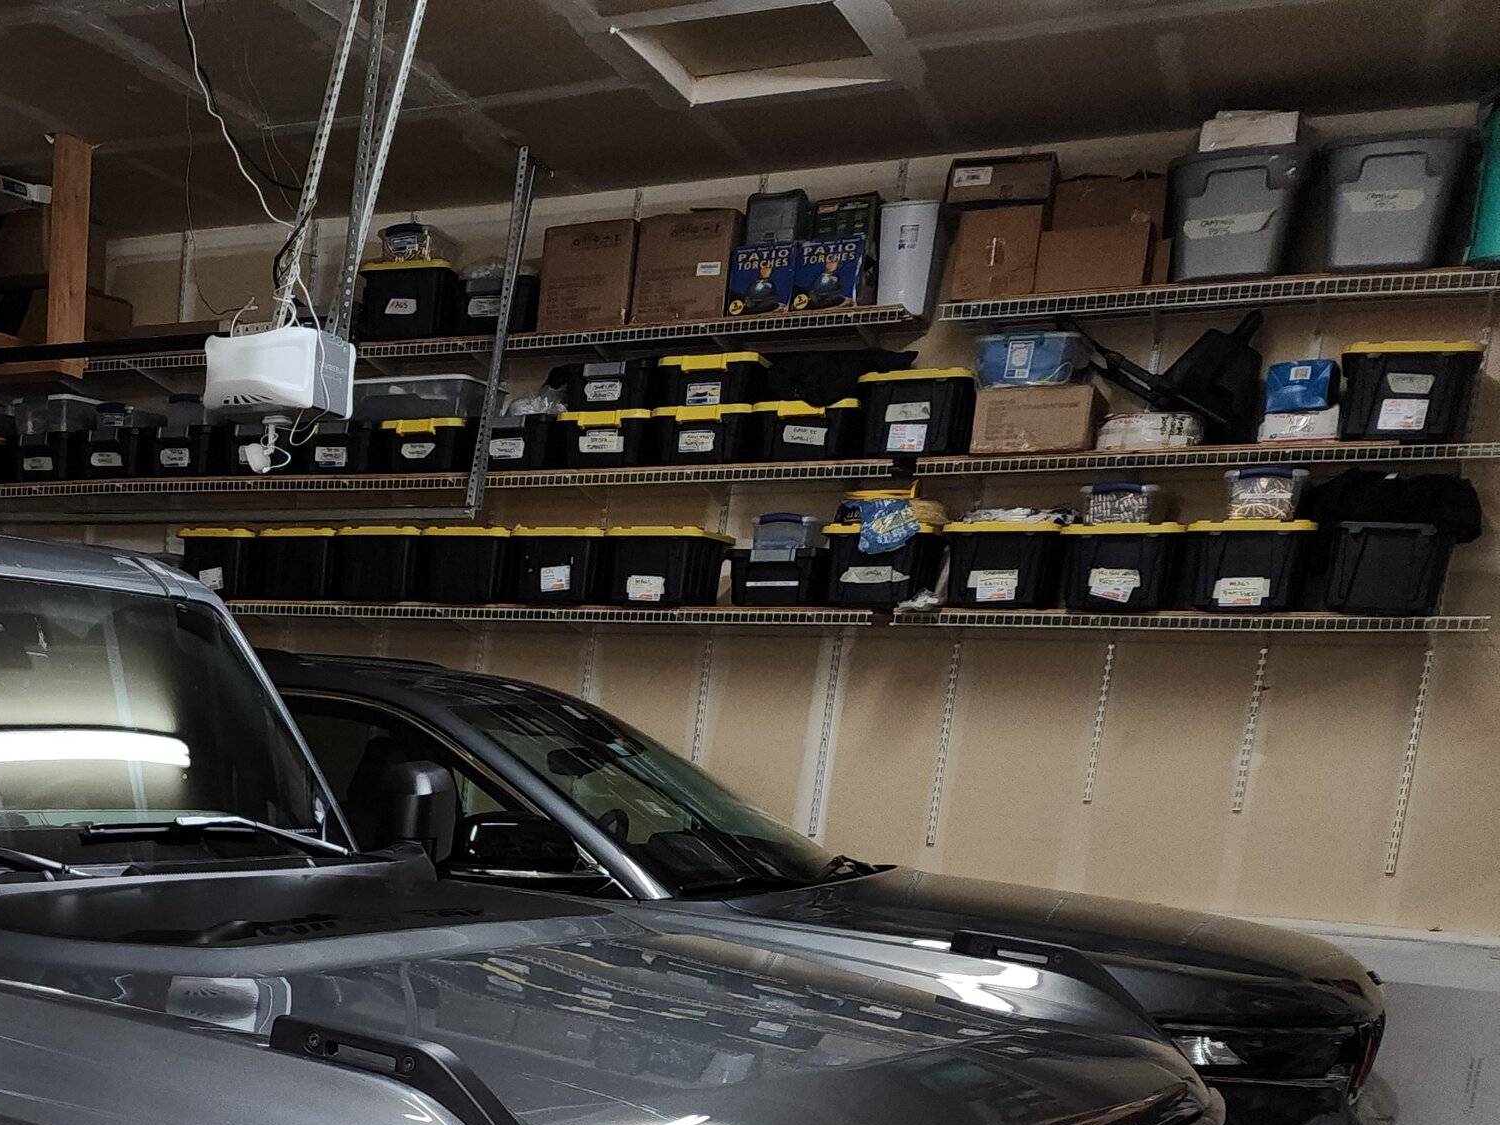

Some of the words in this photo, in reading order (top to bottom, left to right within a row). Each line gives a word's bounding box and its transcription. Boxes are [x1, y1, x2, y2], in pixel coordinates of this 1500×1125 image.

[737, 250, 790, 262] PATIO
[803, 243, 857, 256] PATIO
[738, 258, 789, 272] TORCHES
[803, 252, 856, 265] TORCHES
